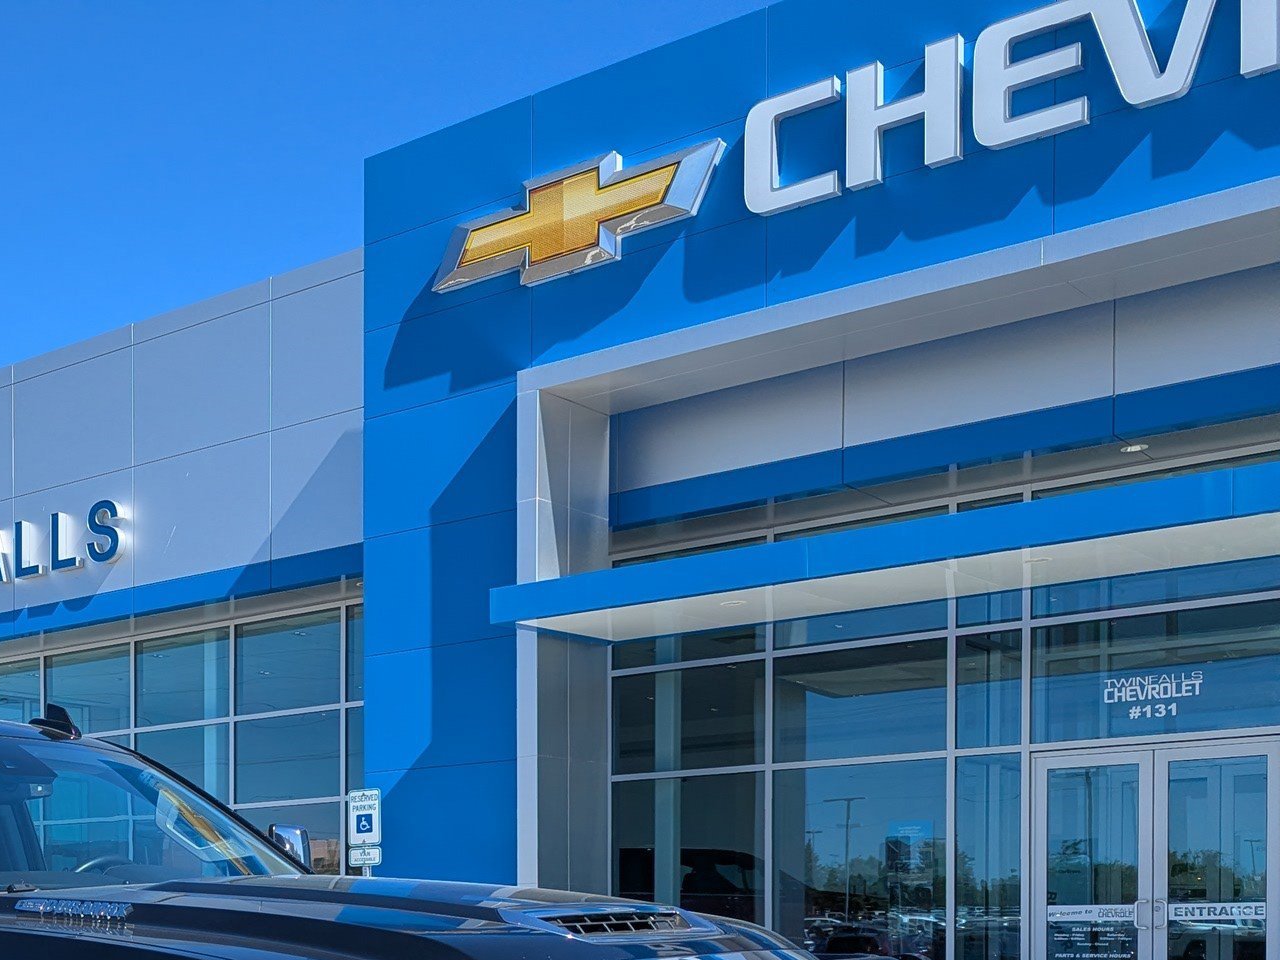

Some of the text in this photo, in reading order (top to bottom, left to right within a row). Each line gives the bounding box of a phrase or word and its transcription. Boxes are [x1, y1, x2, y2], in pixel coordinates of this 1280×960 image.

[1104, 671, 1203, 689] TWINFALLS
[1104, 680, 1203, 704] CHEVROLET
[1129, 703, 1177, 720] #131
[350, 794, 378, 803] RESERVED
[352, 803, 377, 813] PARKING
[1174, 905, 1265, 917] ENTRANCE
